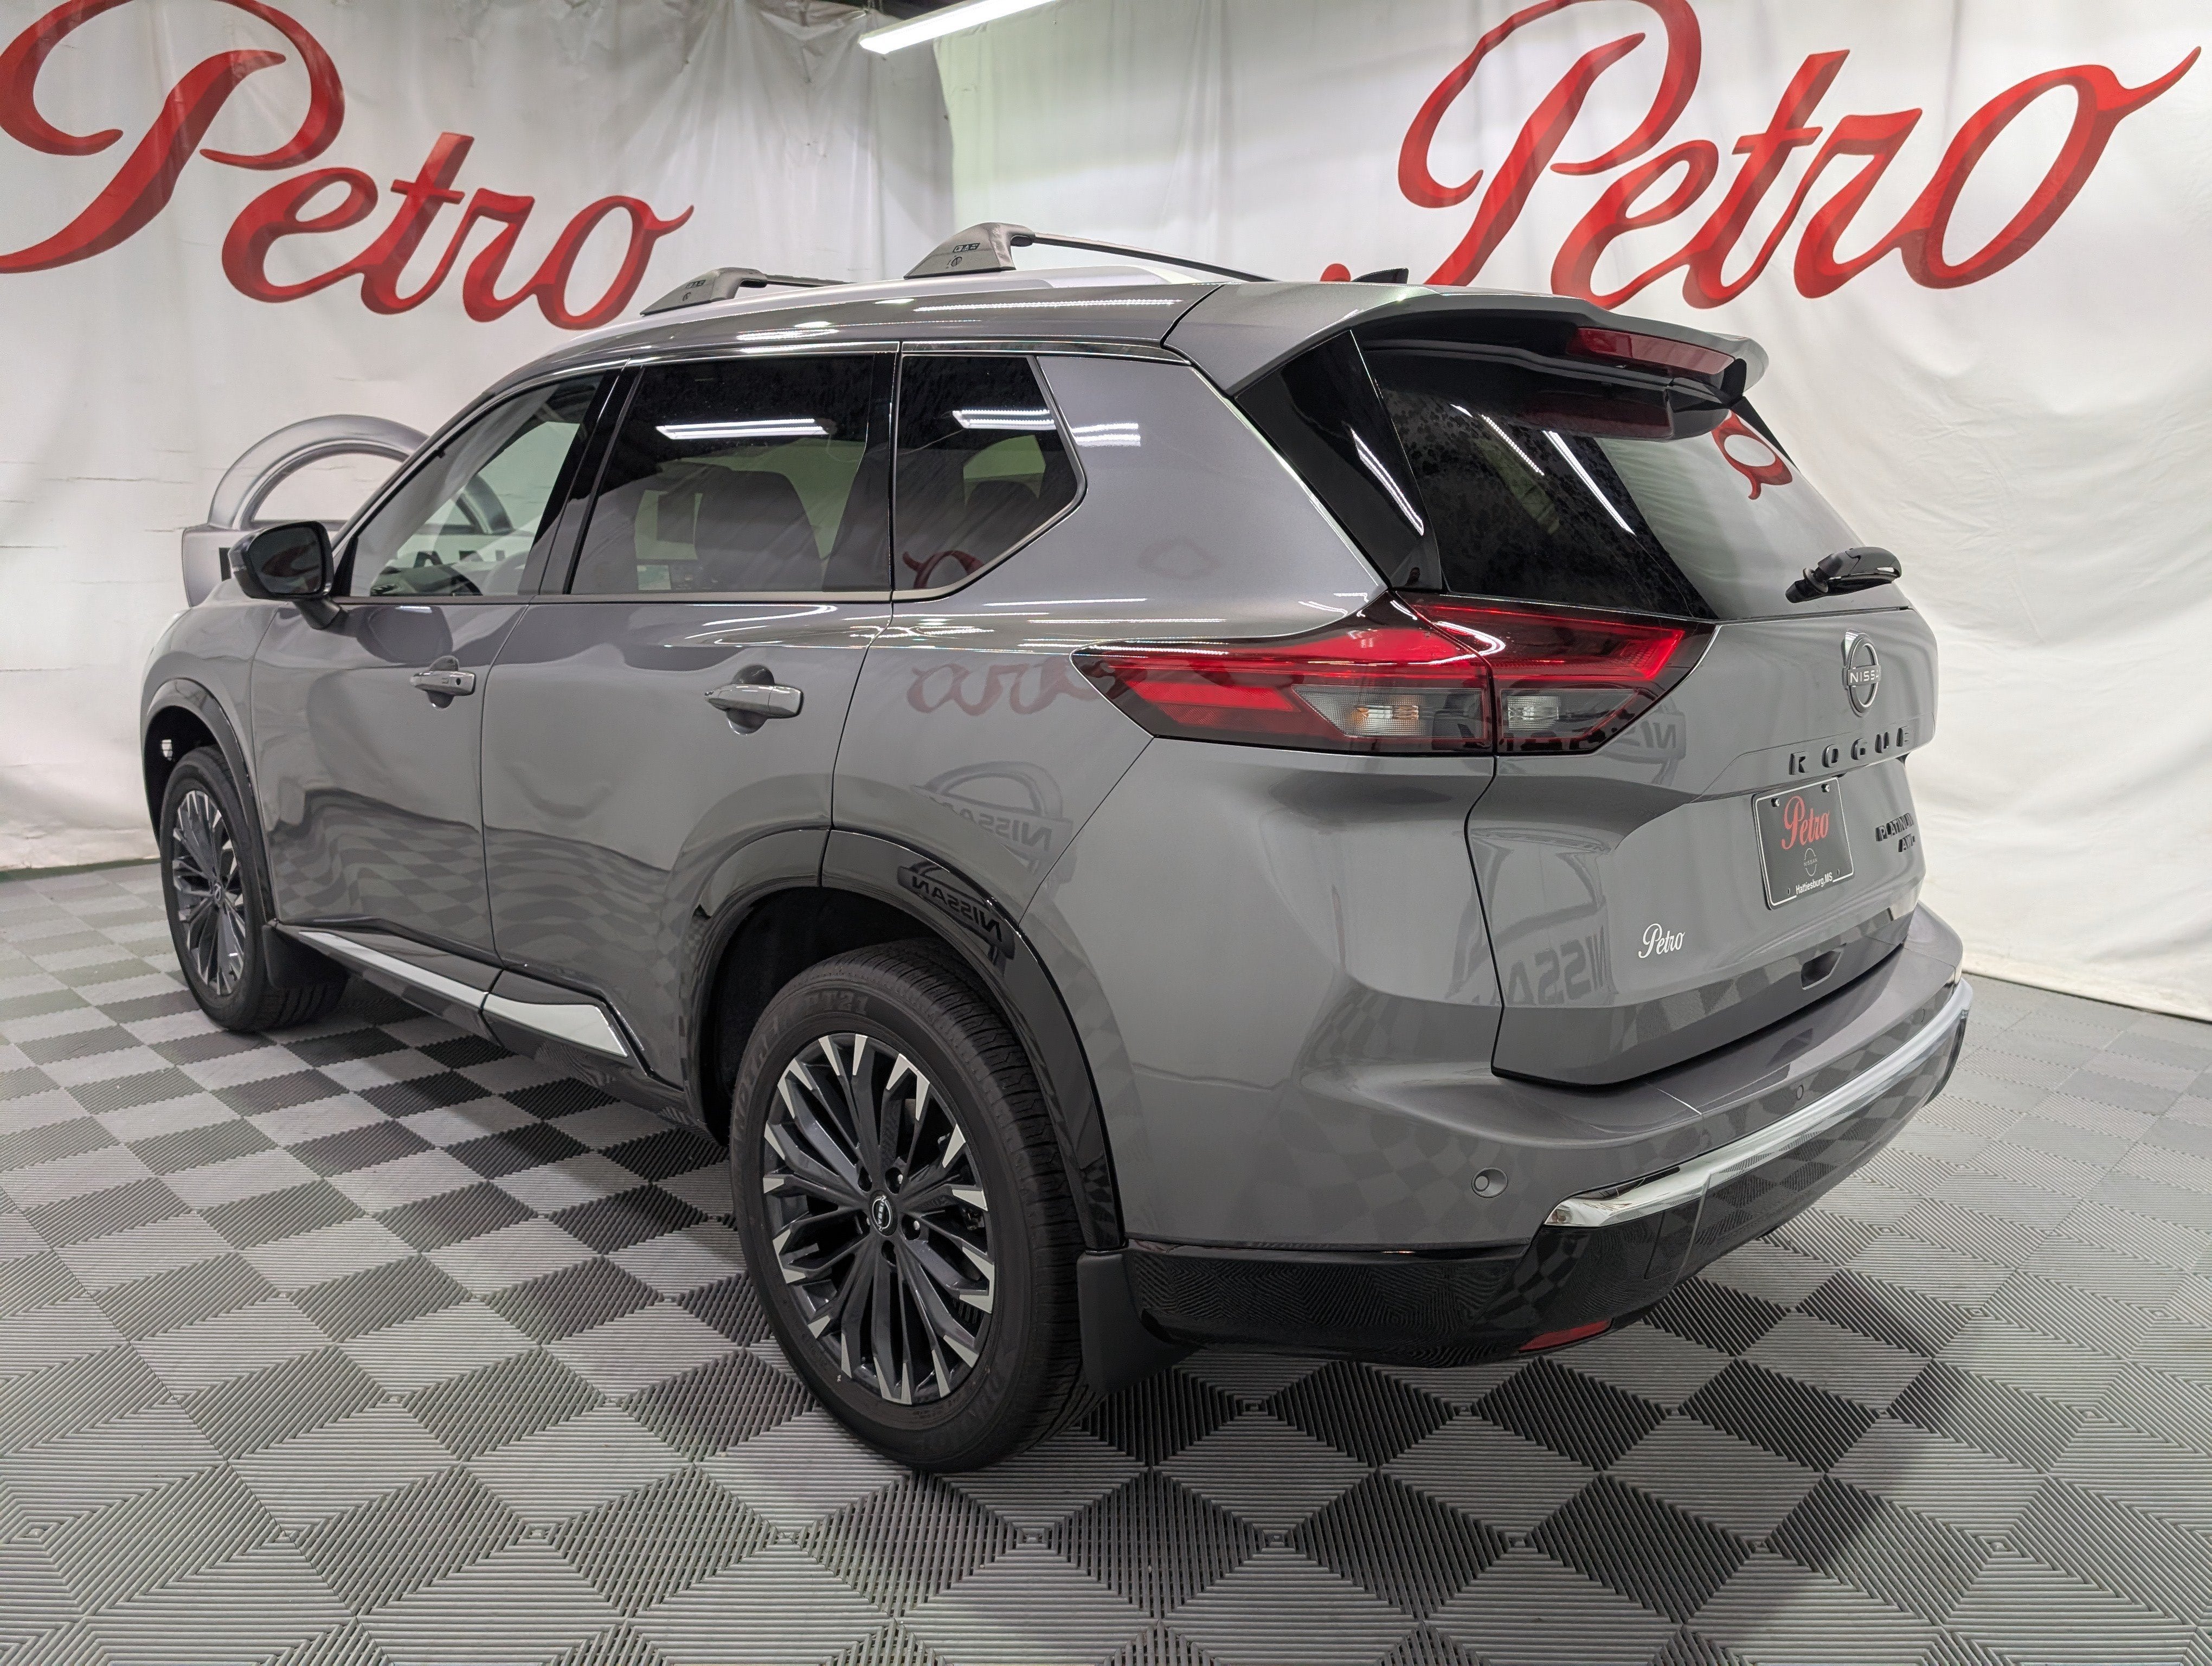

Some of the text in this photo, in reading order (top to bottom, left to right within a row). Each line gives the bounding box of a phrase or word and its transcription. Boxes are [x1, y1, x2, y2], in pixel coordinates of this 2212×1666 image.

[0, 0, 694, 329] Petro
[1321, 0, 2201, 309] Petro
[1850, 669, 1879, 683] NISS
[1789, 725, 1911, 776] ROGUE
[1781, 795, 1830, 850] Petro
[1638, 923, 1685, 958] Petro
[877, 1195, 887, 1232] NISSAN
